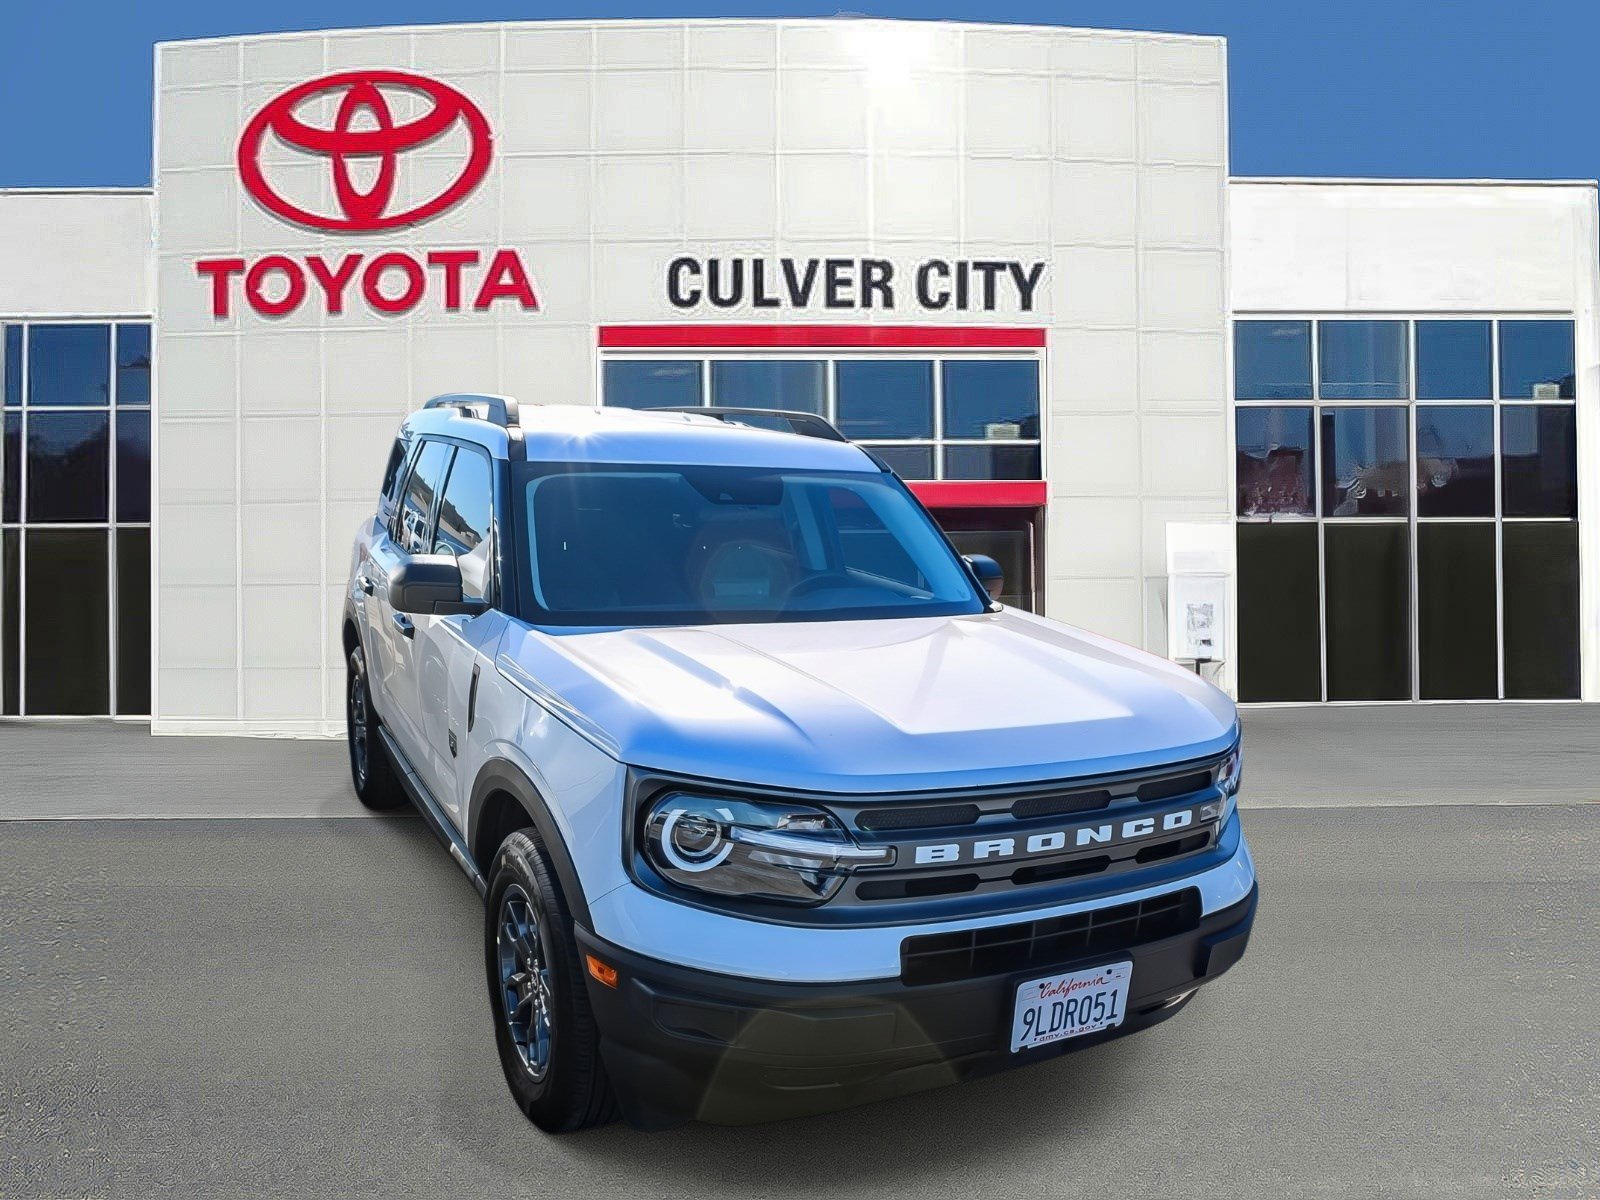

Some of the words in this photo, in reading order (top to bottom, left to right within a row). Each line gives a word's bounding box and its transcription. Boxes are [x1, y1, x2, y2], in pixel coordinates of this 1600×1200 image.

[196, 249, 539, 318] TOYOTA
[668, 257, 895, 309] CULVER
[915, 260, 1045, 311] CITY
[915, 810, 1192, 864] BRONCO
[1040, 975, 1109, 999] California
[1020, 989, 1118, 1042] 9LDR051
[1039, 1023, 1097, 1042] dmv.ca.gov
